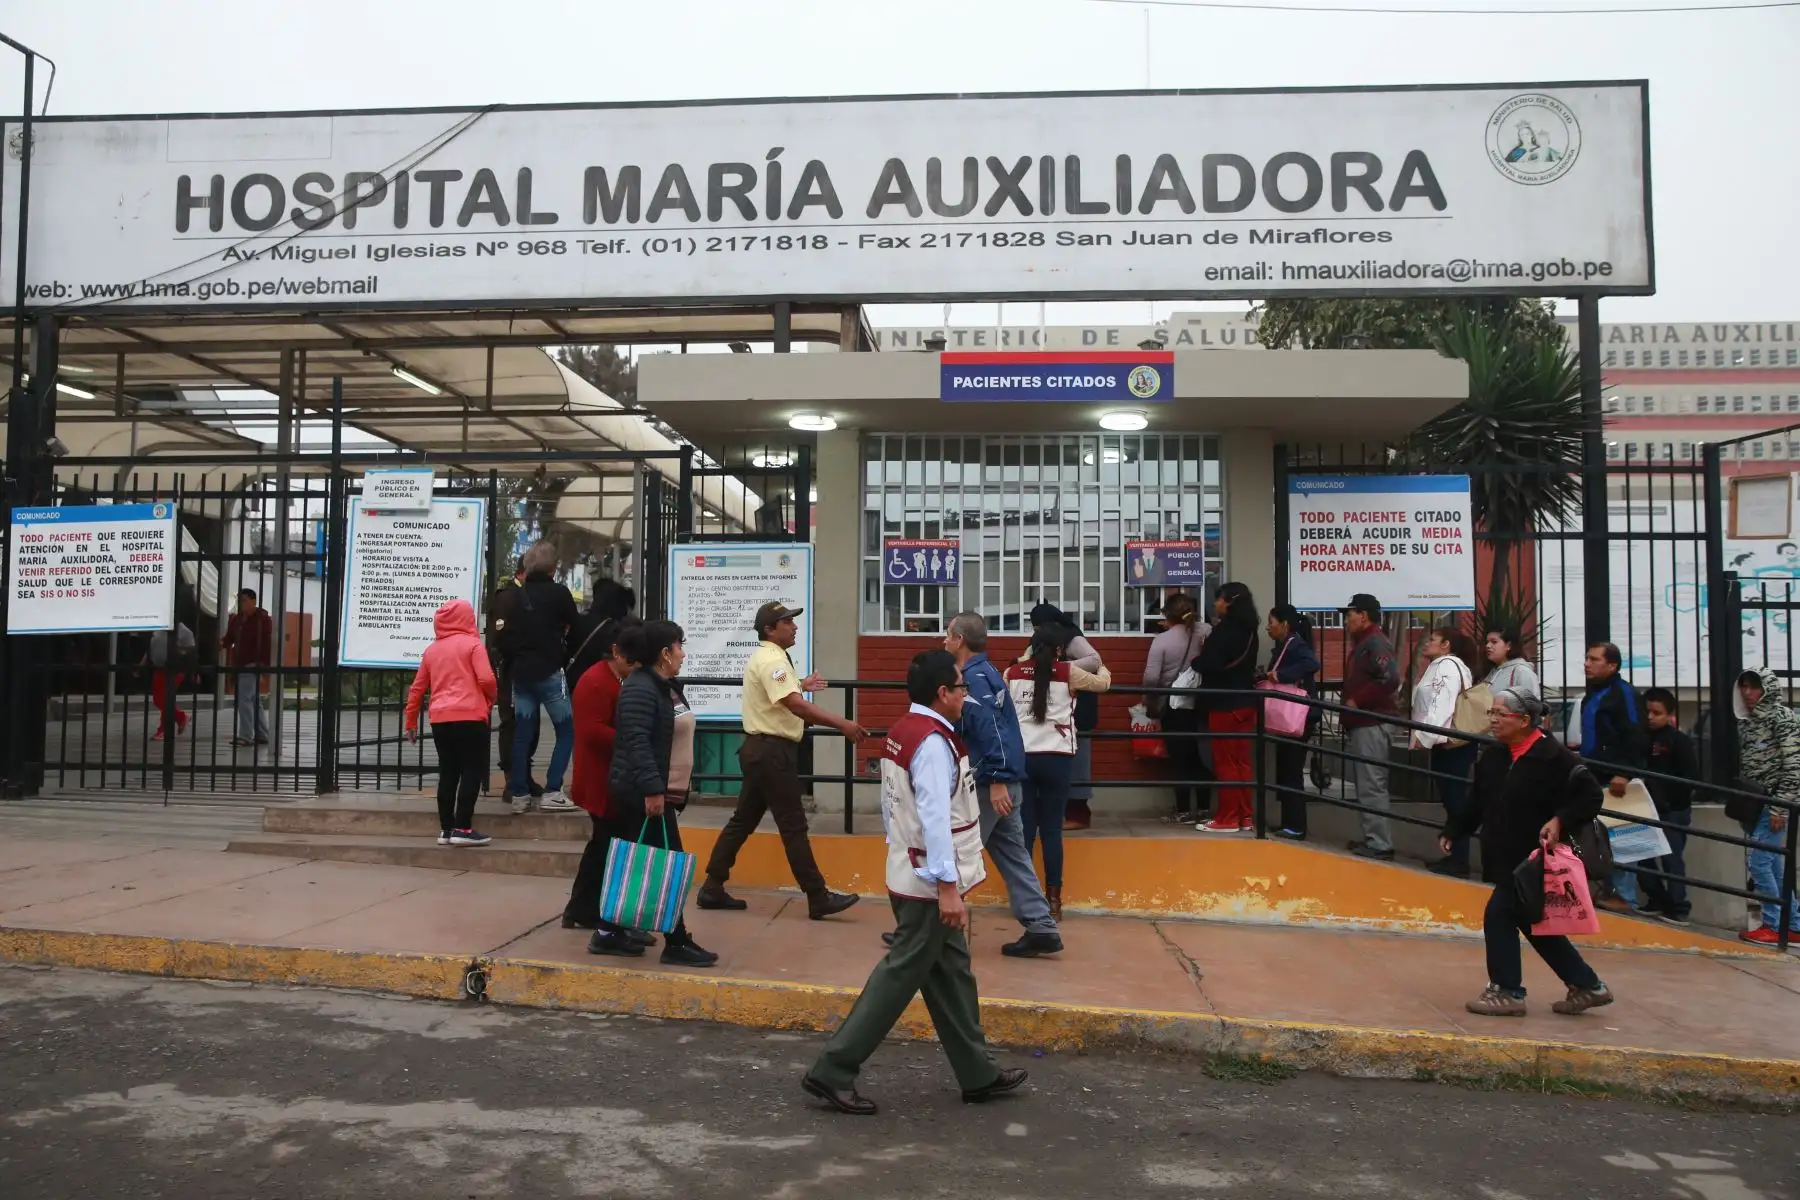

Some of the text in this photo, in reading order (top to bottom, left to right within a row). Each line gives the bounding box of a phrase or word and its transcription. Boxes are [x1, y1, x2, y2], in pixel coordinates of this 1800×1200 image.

[175, 146, 1448, 234] HOSPITAL MARÍA AUXILIADORA
[222, 246, 260, 262] Av.
[271, 245, 356, 264] Miguel
[366, 242, 466, 262] Iglesias
[516, 239, 567, 256] 968
[576, 239, 631, 256] Telf.
[641, 237, 697, 258] (01)
[707, 234, 828, 253] 2171818
[858, 233, 911, 250] Fax
[919, 231, 1046, 249] 2171828
[1055, 230, 1112, 247] San
[1122, 229, 1191, 246] Juan
[1202, 228, 1239, 245] de
[1248, 226, 1394, 245] Miraflores
[1203, 257, 1613, 283] email: hmauxiliadora@hma.gob.pe
[24, 275, 378, 300] web: www.hma.gob.pe/webmail
[1081, 328, 1120, 346] DE
[1600, 323, 1800, 343] ARIA AUXILI
[953, 375, 1117, 388] PACIENTES CITADOS
[1295, 481, 1345, 490] COMUNICADO
[16, 511, 61, 520] COMUNICADO
[1299, 510, 1462, 524] TODO PACIENTE CITADO
[393, 522, 450, 530] COMUNICADO
[1299, 525, 1462, 540] DEBERÁ ACUDIR MEDIA
[20, 530, 165, 543] TODO PACIENTE QUE REQUIERE
[19, 541, 164, 554] ATENCIÓN EN EL HOSPITAL
[1300, 543, 1463, 556] HORA ANTES DE SU CITA
[60, 554, 117, 565] AUXILIDORA,
[1300, 559, 1396, 572] PROGRAMADA.
[18, 564, 164, 577] VENIR REFERIDO DEL CENTRO DE
[18, 575, 164, 588] SALUD QUE LE CORRESPONDE
[17, 588, 96, 599] SEA SIS O NO SIS
